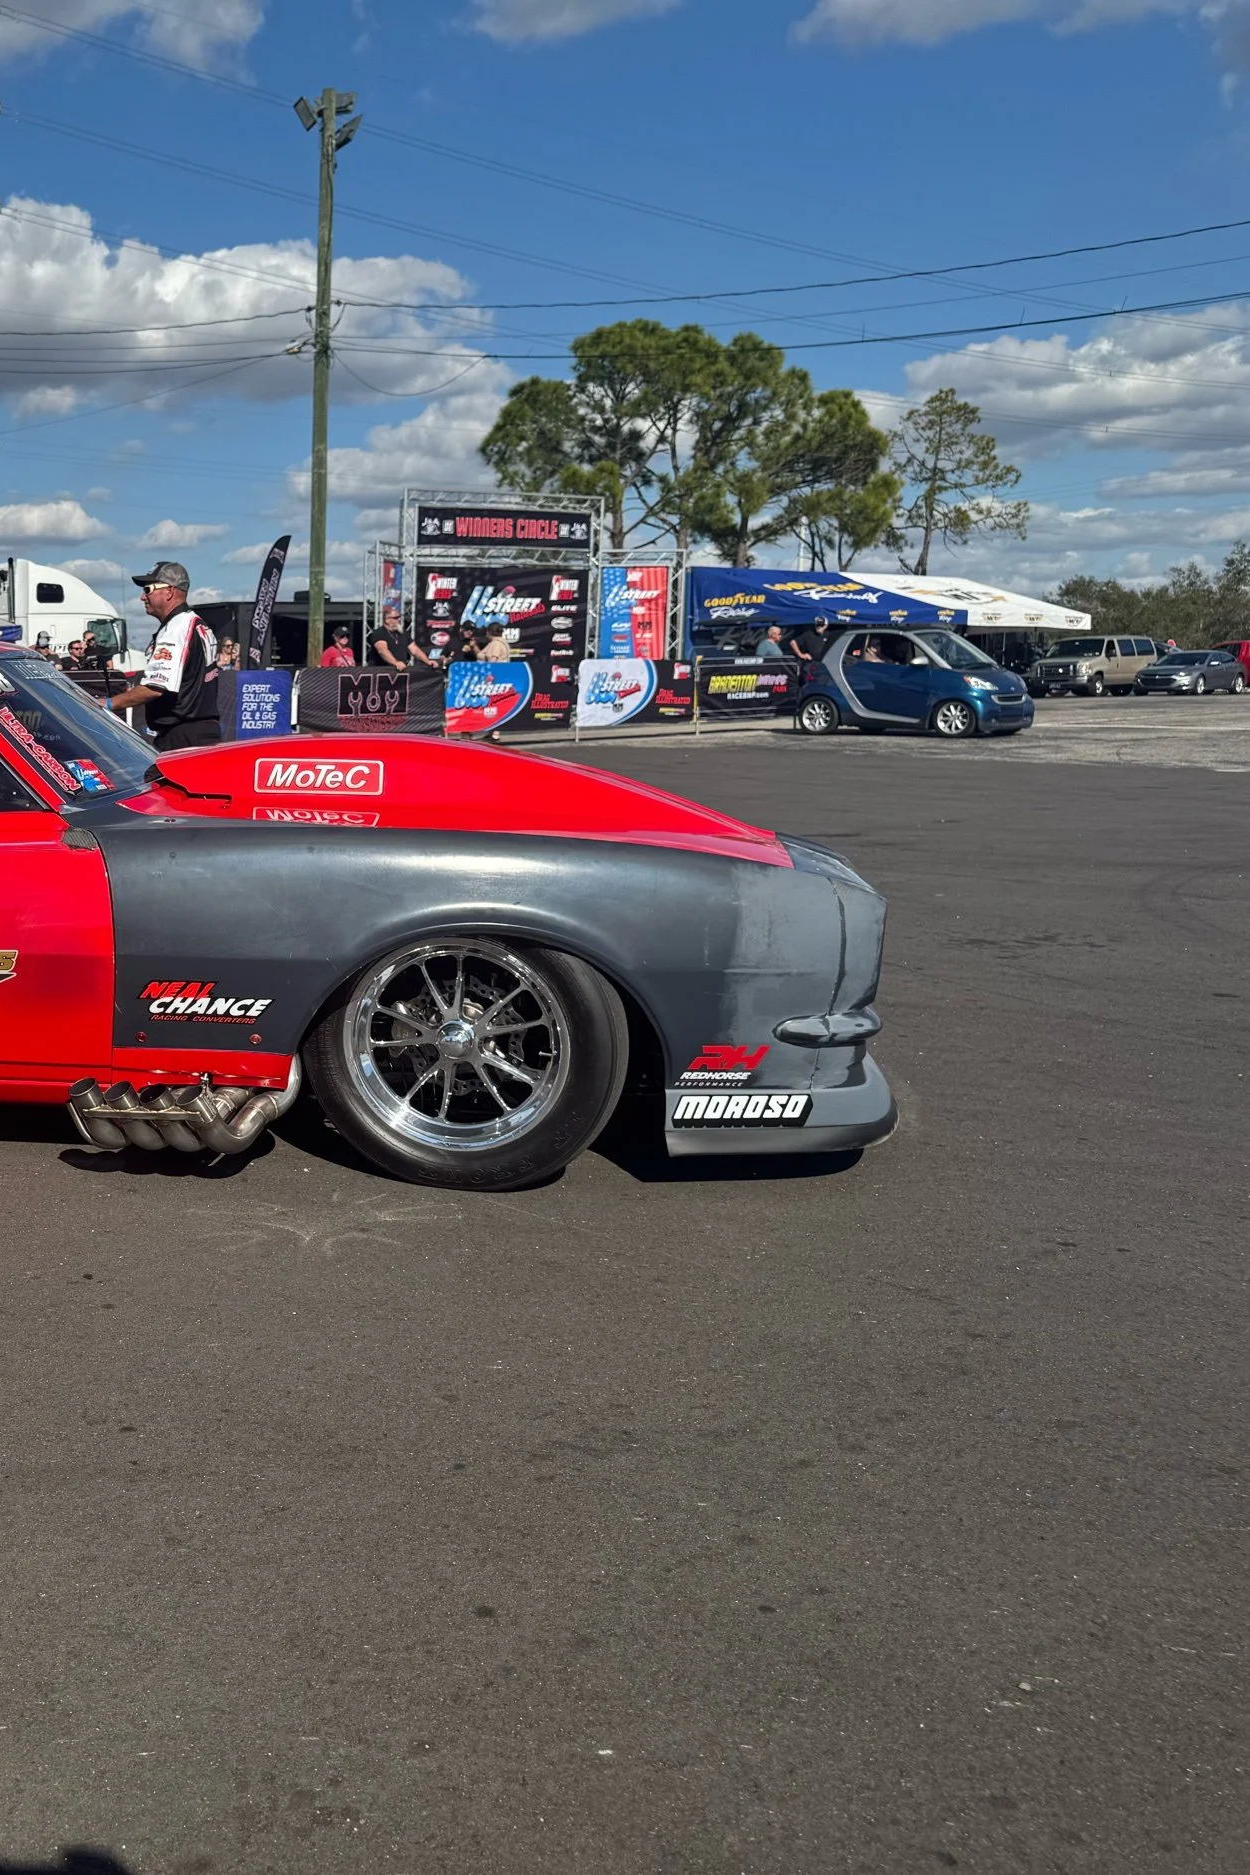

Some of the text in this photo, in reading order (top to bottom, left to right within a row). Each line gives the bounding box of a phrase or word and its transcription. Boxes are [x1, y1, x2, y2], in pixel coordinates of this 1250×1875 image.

[455, 517, 513, 539] WINNERS
[516, 519, 558, 540] CIRCLE
[484, 597, 543, 613] STREET
[704, 593, 766, 608] GOODYEAR
[242, 684, 271, 693] EXPERT
[471, 682, 514, 696] STREET
[708, 674, 757, 694] BRADENTON
[242, 694, 281, 702] SOLUTIONS
[242, 703, 275, 711] FOR THE
[242, 712, 278, 720] OIL & GAS
[242, 721, 277, 729] INDUSTRY
[266, 763, 370, 789] MoTeC
[140, 981, 215, 999] NEAL
[149, 997, 273, 1017] CHANCE
[150, 1014, 256, 1025] RACING CONVERTERS
[679, 1071, 752, 1080] REDHORSE
[672, 1095, 810, 1122] MOROSO
